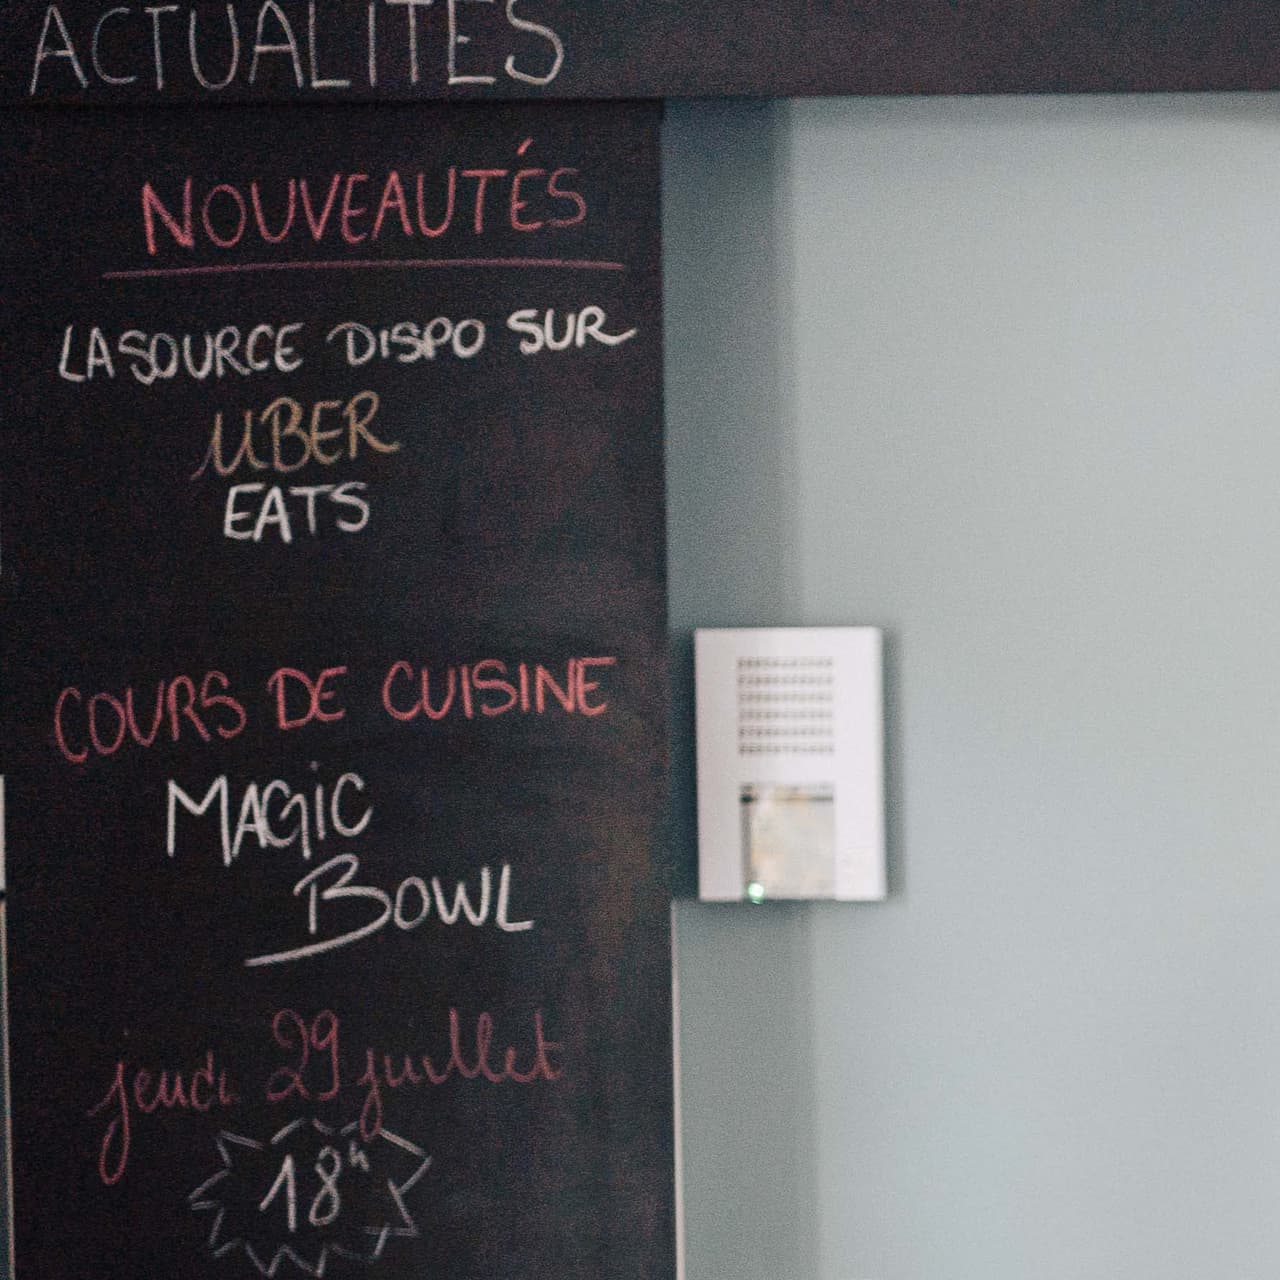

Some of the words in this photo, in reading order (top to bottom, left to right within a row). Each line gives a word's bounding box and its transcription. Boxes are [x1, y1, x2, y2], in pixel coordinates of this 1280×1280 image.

[141, 139, 587, 255] NOUVEAUTÉS
[326, 316, 486, 366] DISPO
[507, 305, 637, 354] SUR
[191, 389, 400, 479] UBER
[223, 480, 371, 543] EATS
[54, 671, 247, 764] COURS
[268, 666, 349, 730] DE
[382, 656, 617, 721] CUISINE
[87, 1031, 234, 1185] jeudi
[266, 1008, 341, 1101] 29
[357, 1007, 562, 1141] juillet
